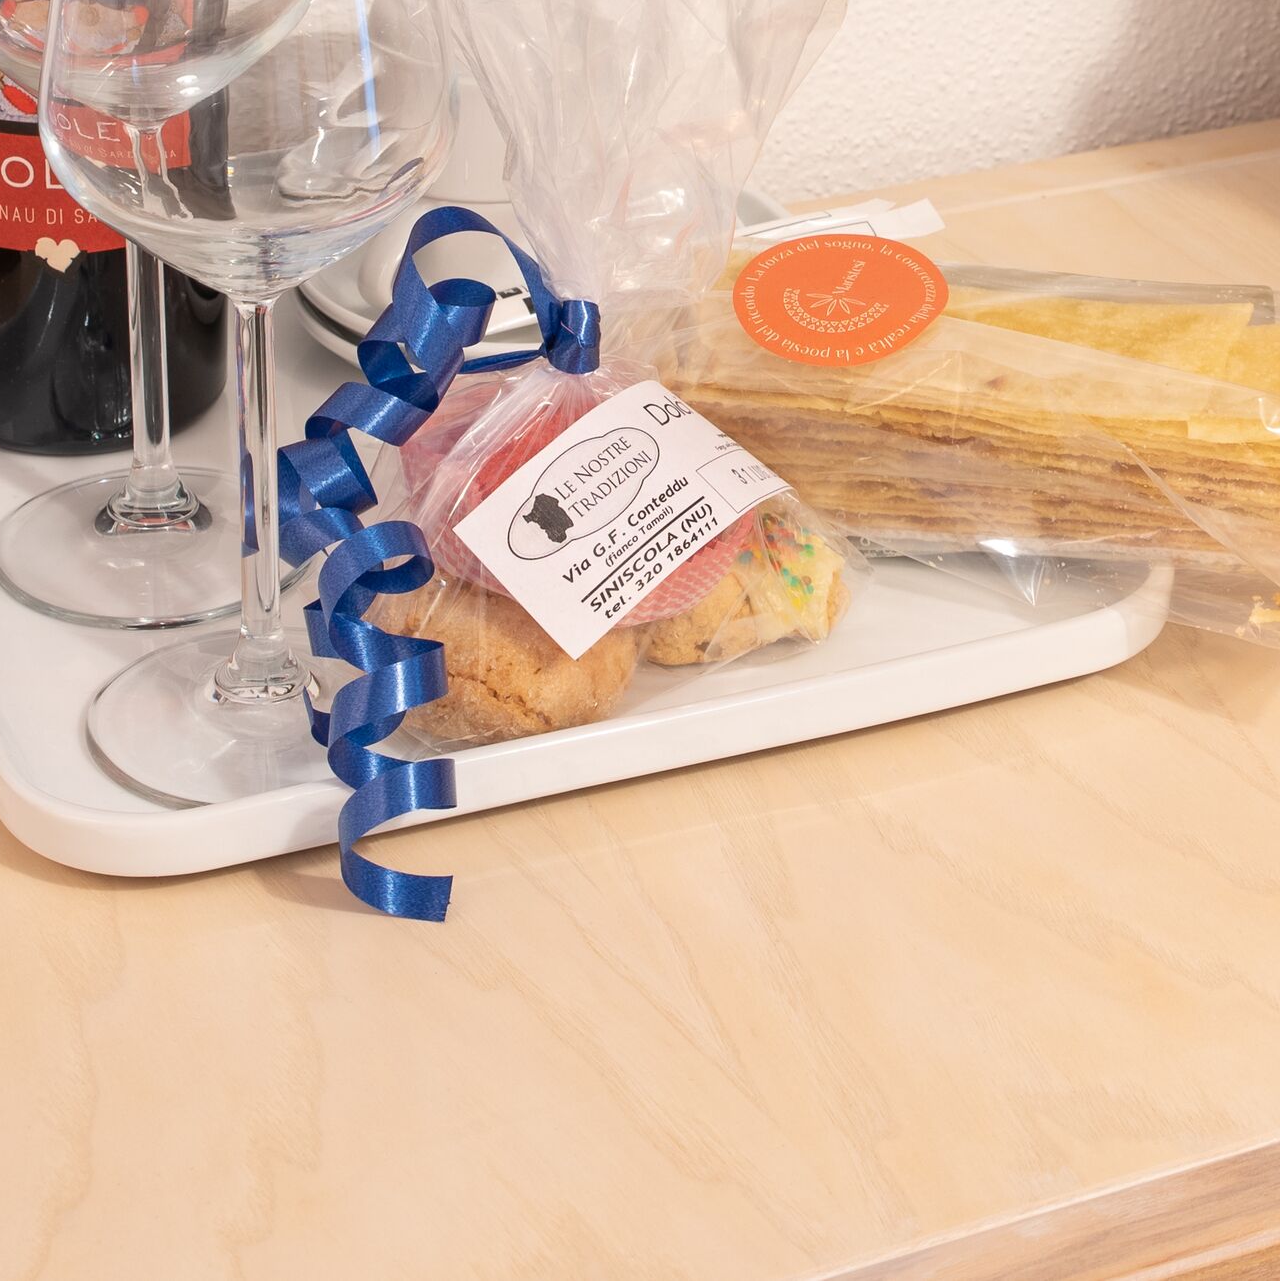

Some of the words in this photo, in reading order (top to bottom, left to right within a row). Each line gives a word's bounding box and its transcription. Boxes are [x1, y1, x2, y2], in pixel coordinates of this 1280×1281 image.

[46, 208, 64, 225] DI
[797, 239, 820, 252] del
[879, 244, 893, 256] la
[758, 248, 794, 270] forza
[745, 269, 765, 282] La
[739, 285, 764, 325] ricordo
[908, 303, 936, 324] della
[755, 324, 780, 342] del
[780, 338, 831, 358] poesia
[835, 349, 850, 363] la
[855, 346, 864, 357] e
[554, 480, 578, 501] LE
[573, 436, 632, 484] NOSTRE
[567, 450, 653, 518] TRADIZIONI
[562, 558, 592, 584] Via
[627, 476, 689, 527] Conteddu
[604, 535, 639, 568] (fianco
[638, 505, 674, 536] Tamoil)
[589, 531, 679, 613] SINISCOLA
[680, 503, 713, 533] (NU)
[604, 595, 632, 619] tel.
[635, 562, 663, 592] 320
[666, 517, 719, 563] 1864111
